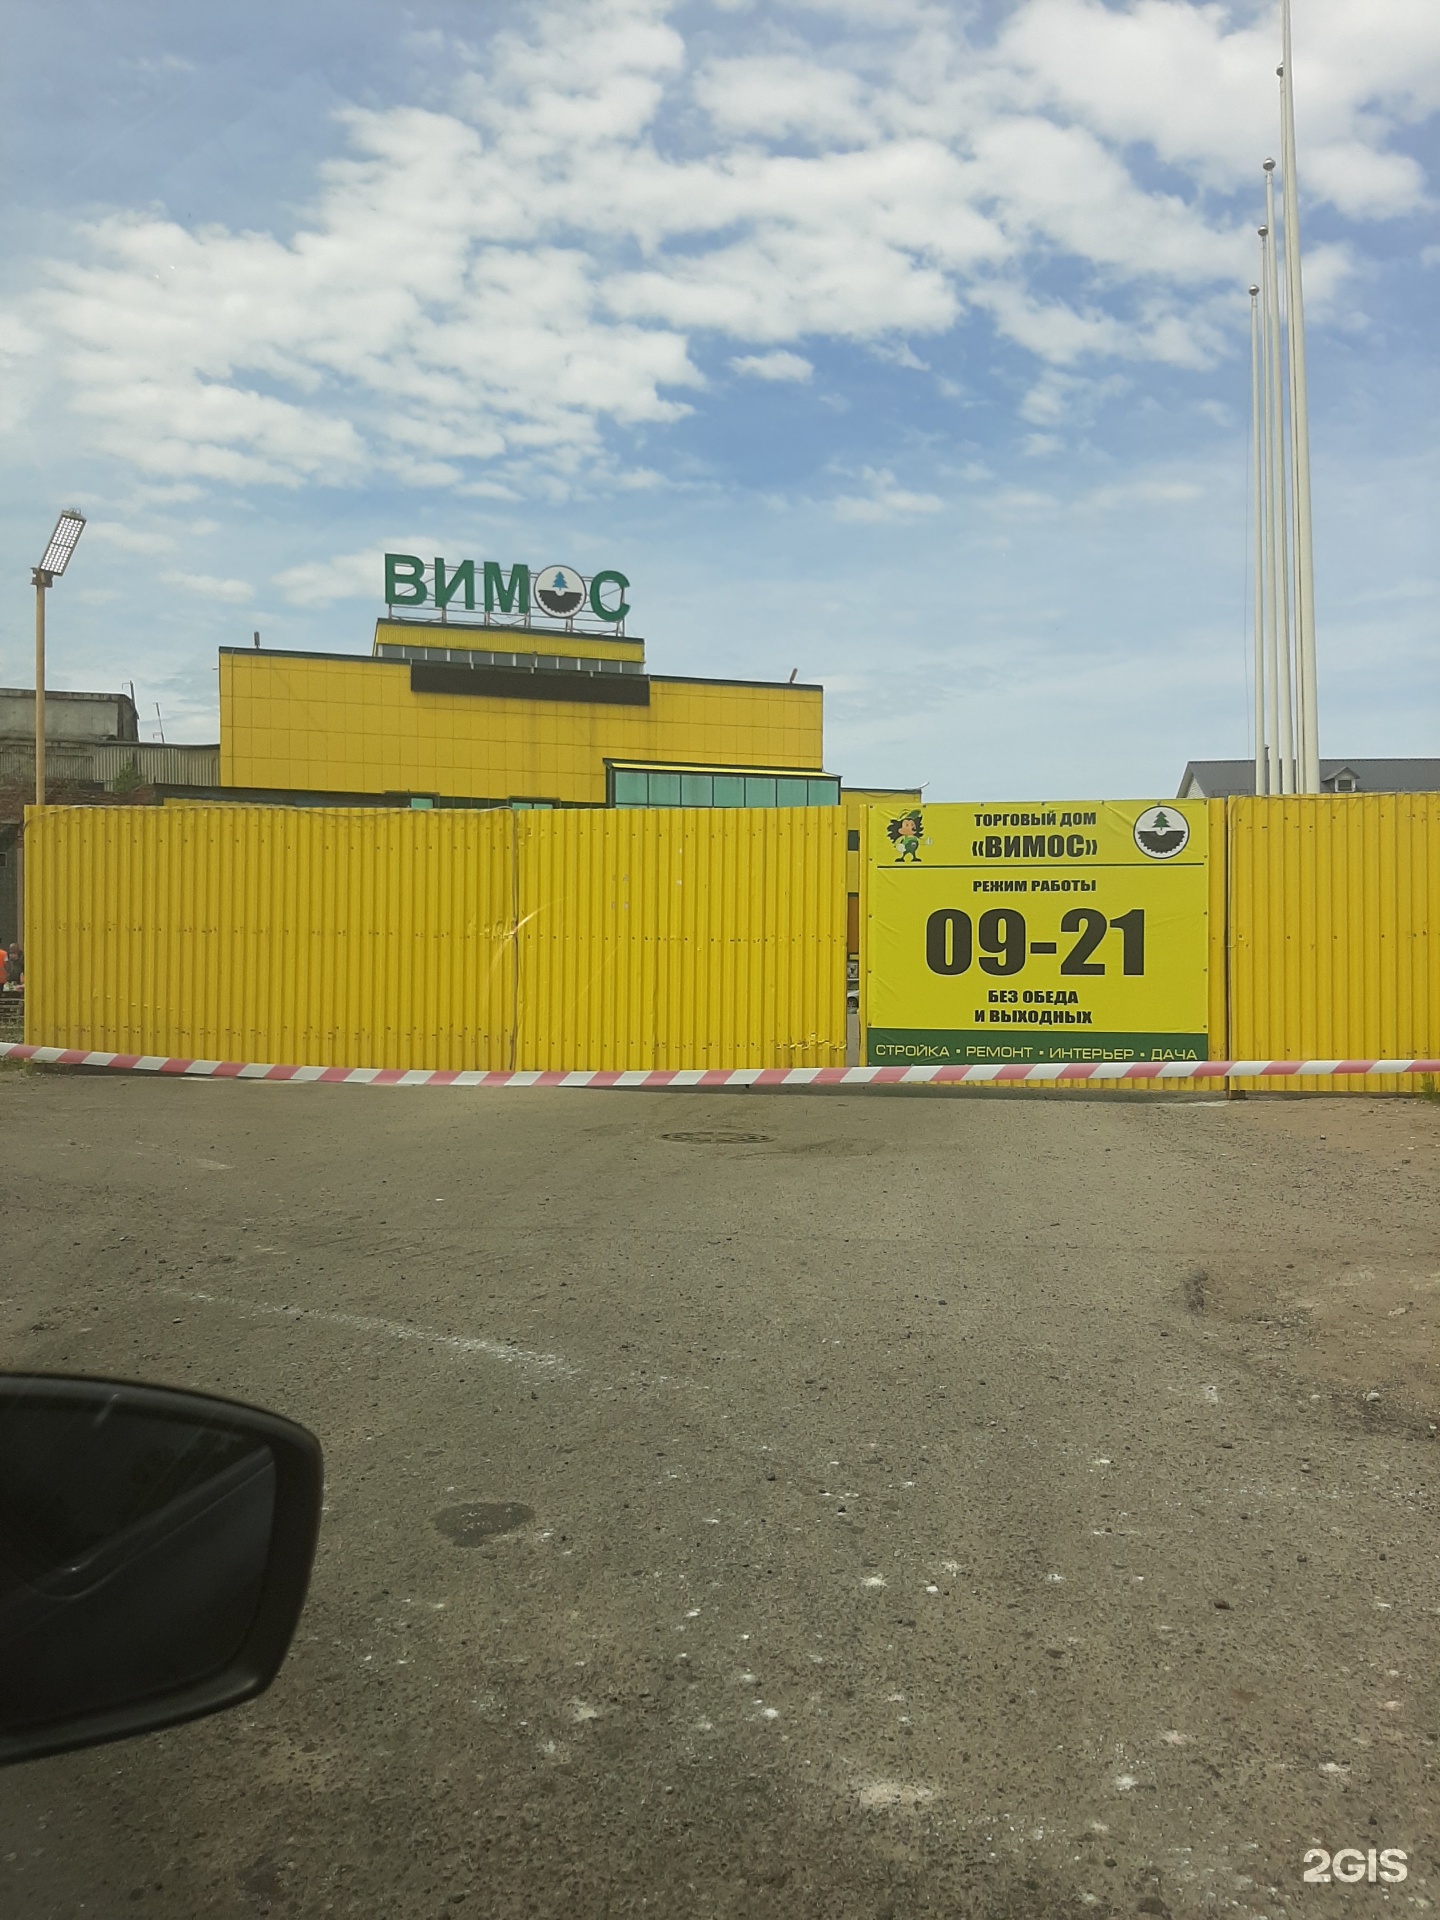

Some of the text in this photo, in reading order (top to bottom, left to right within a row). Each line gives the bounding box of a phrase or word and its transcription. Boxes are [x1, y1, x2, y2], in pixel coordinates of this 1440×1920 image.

[974, 810, 1096, 827] ТОРГОВЫЙ ДОМ
[972, 834, 1098, 859] «ВИМОС»
[973, 879, 1096, 892] РЕЖИМ РАБОТЫ
[925, 908, 1145, 976] 09-21
[988, 990, 1079, 1005] БЕЗ ОБЕДА
[974, 1010, 1093, 1025] И ВЫХОДНЫХ
[876, 1043, 1197, 1061] СТРОЙКА РЕМОНТ ИНТЕРЬЕР ДАЧА
